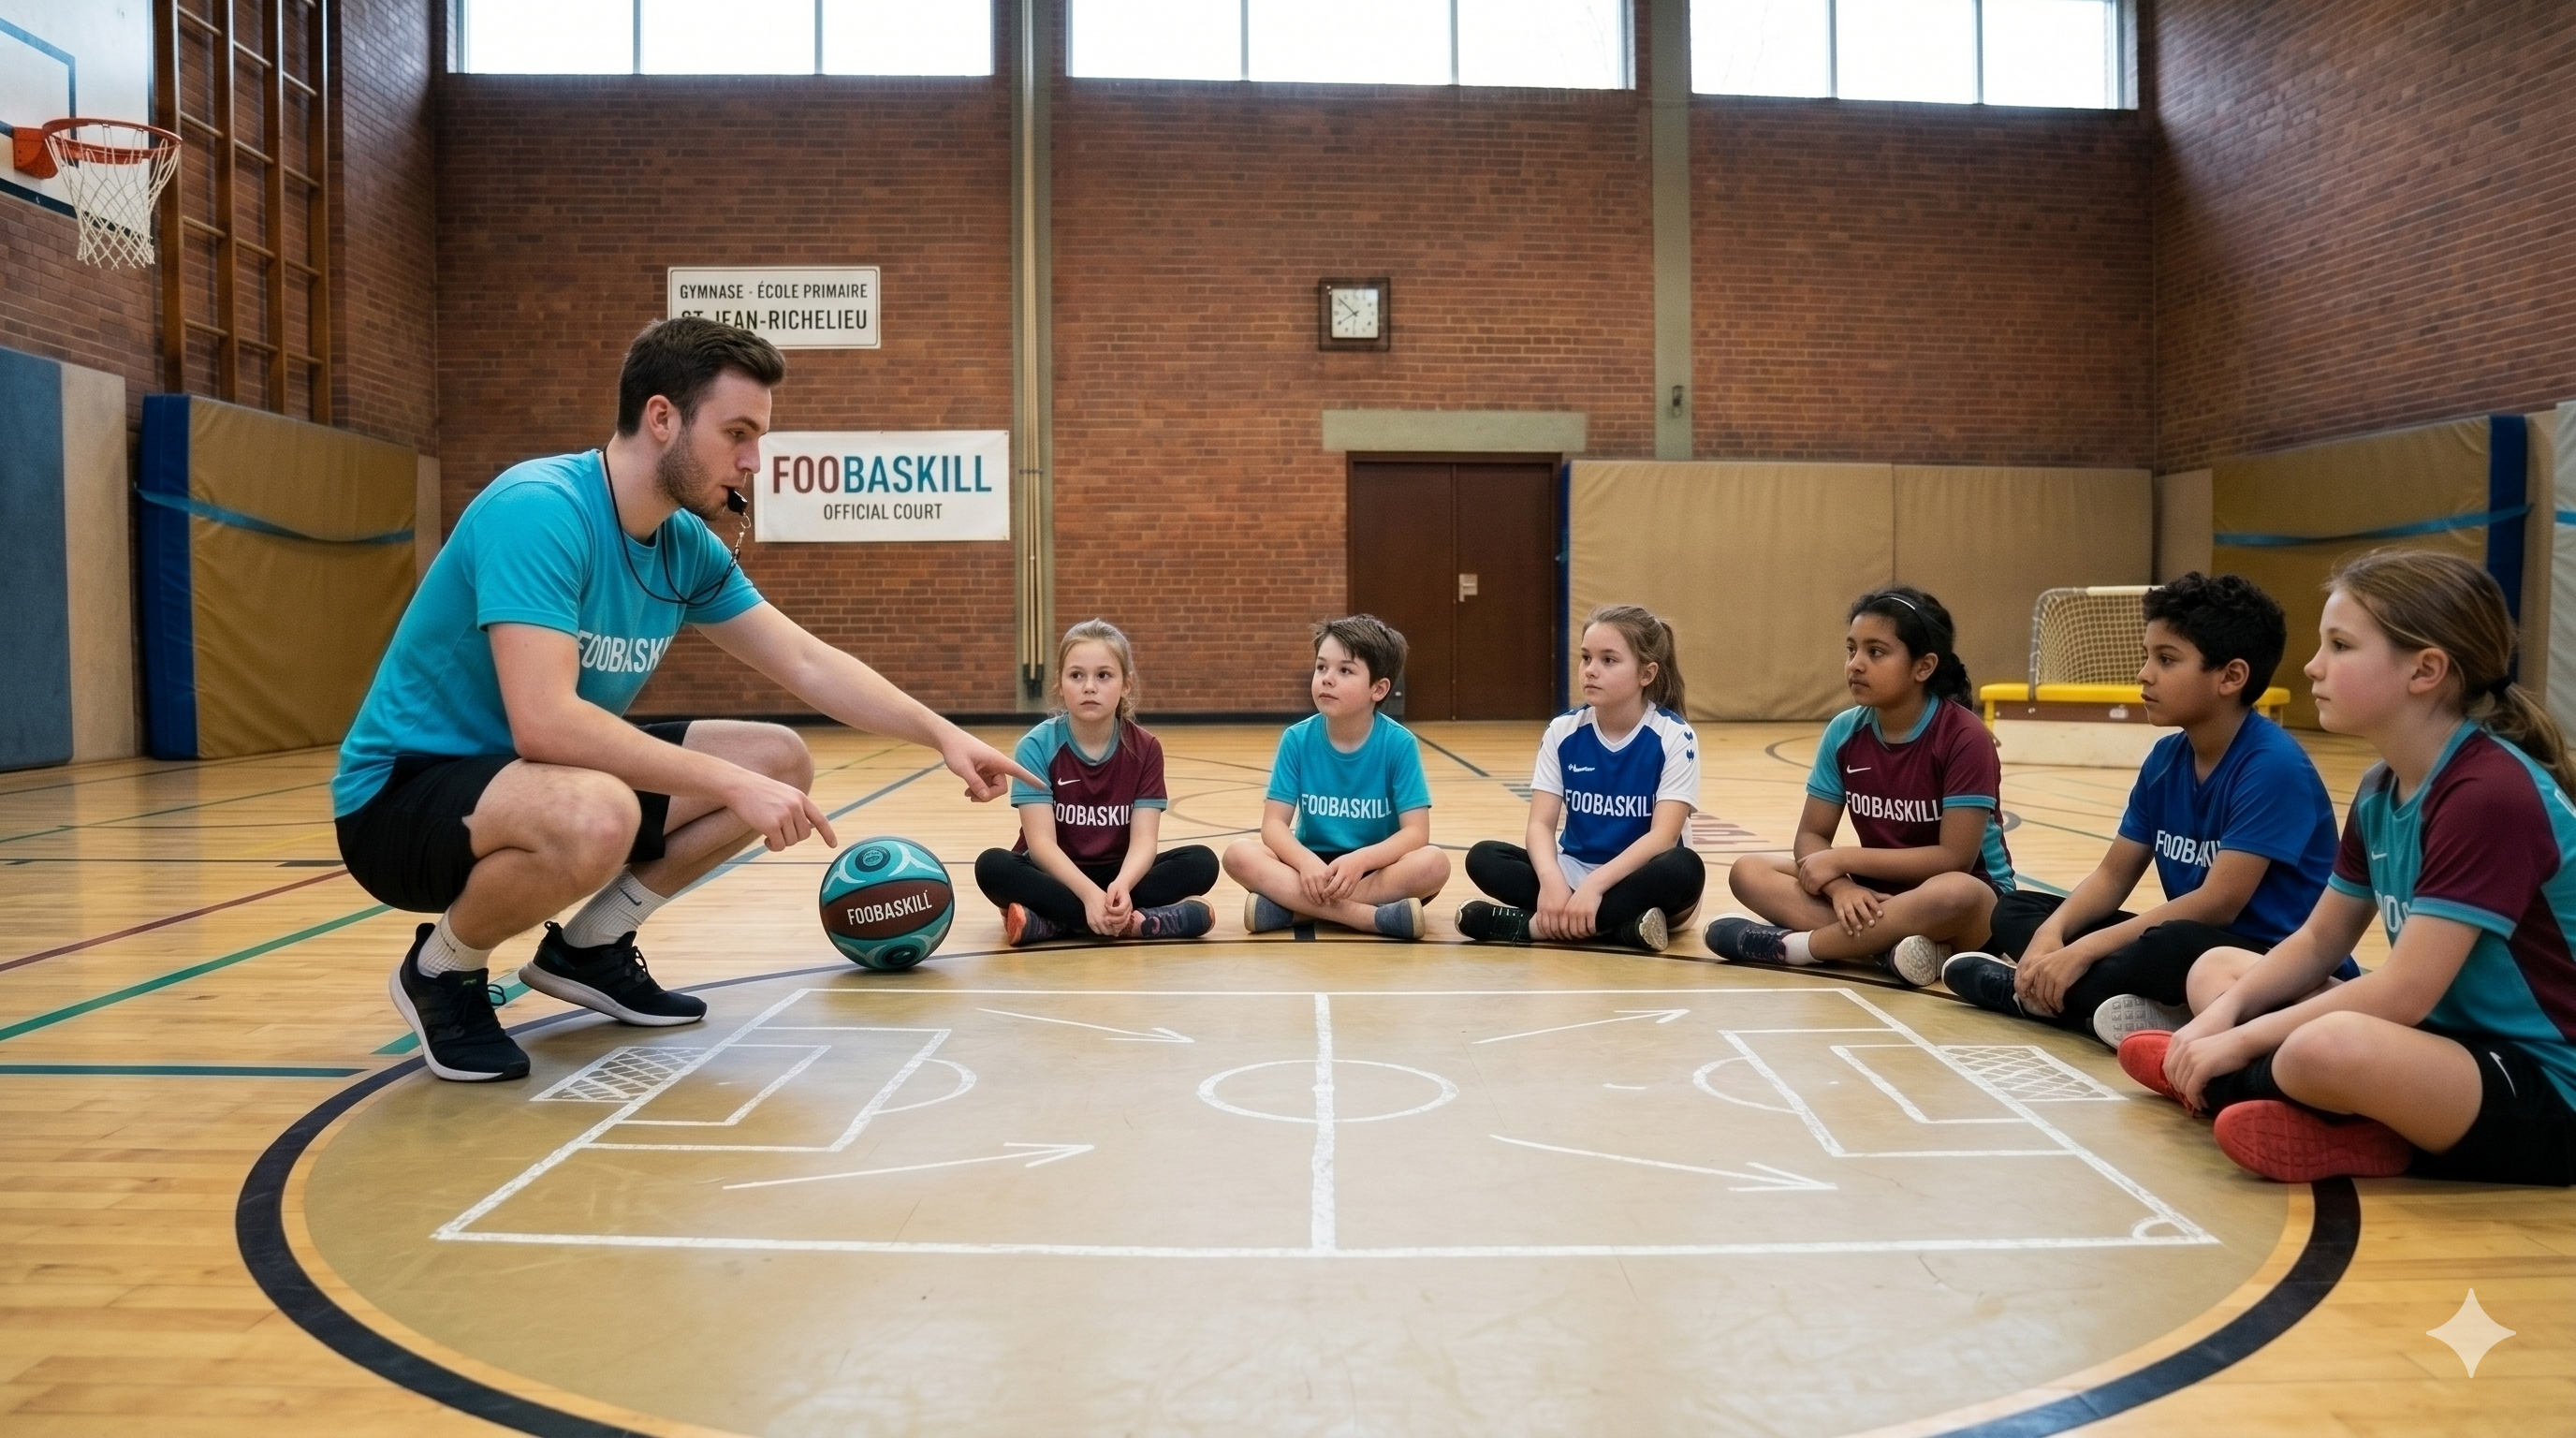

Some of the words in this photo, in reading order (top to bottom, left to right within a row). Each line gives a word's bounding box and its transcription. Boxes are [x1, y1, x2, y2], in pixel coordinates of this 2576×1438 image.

[680, 284, 744, 300] GYMNASE
[757, 281, 799, 299] ÉCOLE
[803, 284, 868, 299] PRIMAIRE
[772, 455, 992, 494] FOOBASKILL
[824, 504, 889, 520] OFFICIAL
[893, 503, 943, 520] COURT
[1053, 800, 1134, 827] OOBASKIL
[1301, 793, 1392, 819] FOOBASKILL
[1565, 789, 1656, 817] FOOBASKIL
[846, 891, 932, 925] FOOBASKILL
